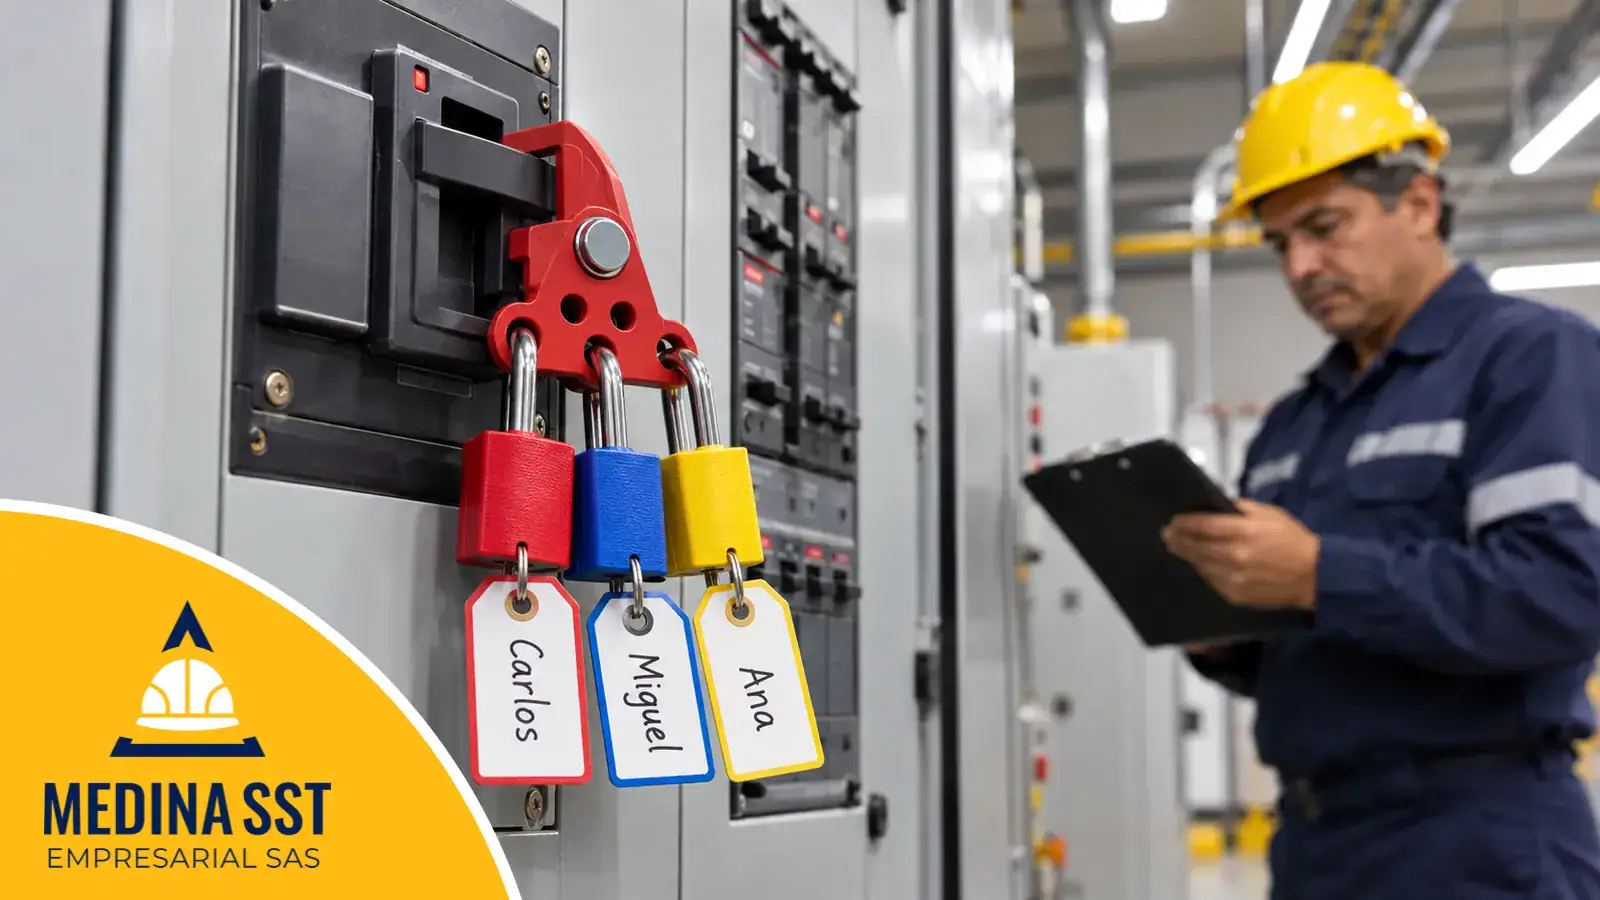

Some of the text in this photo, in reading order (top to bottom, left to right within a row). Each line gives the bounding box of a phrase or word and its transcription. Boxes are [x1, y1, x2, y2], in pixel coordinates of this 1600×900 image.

[509, 639, 551, 742] Carlos
[623, 653, 683, 753] Miguel
[739, 667, 775, 732] Ana
